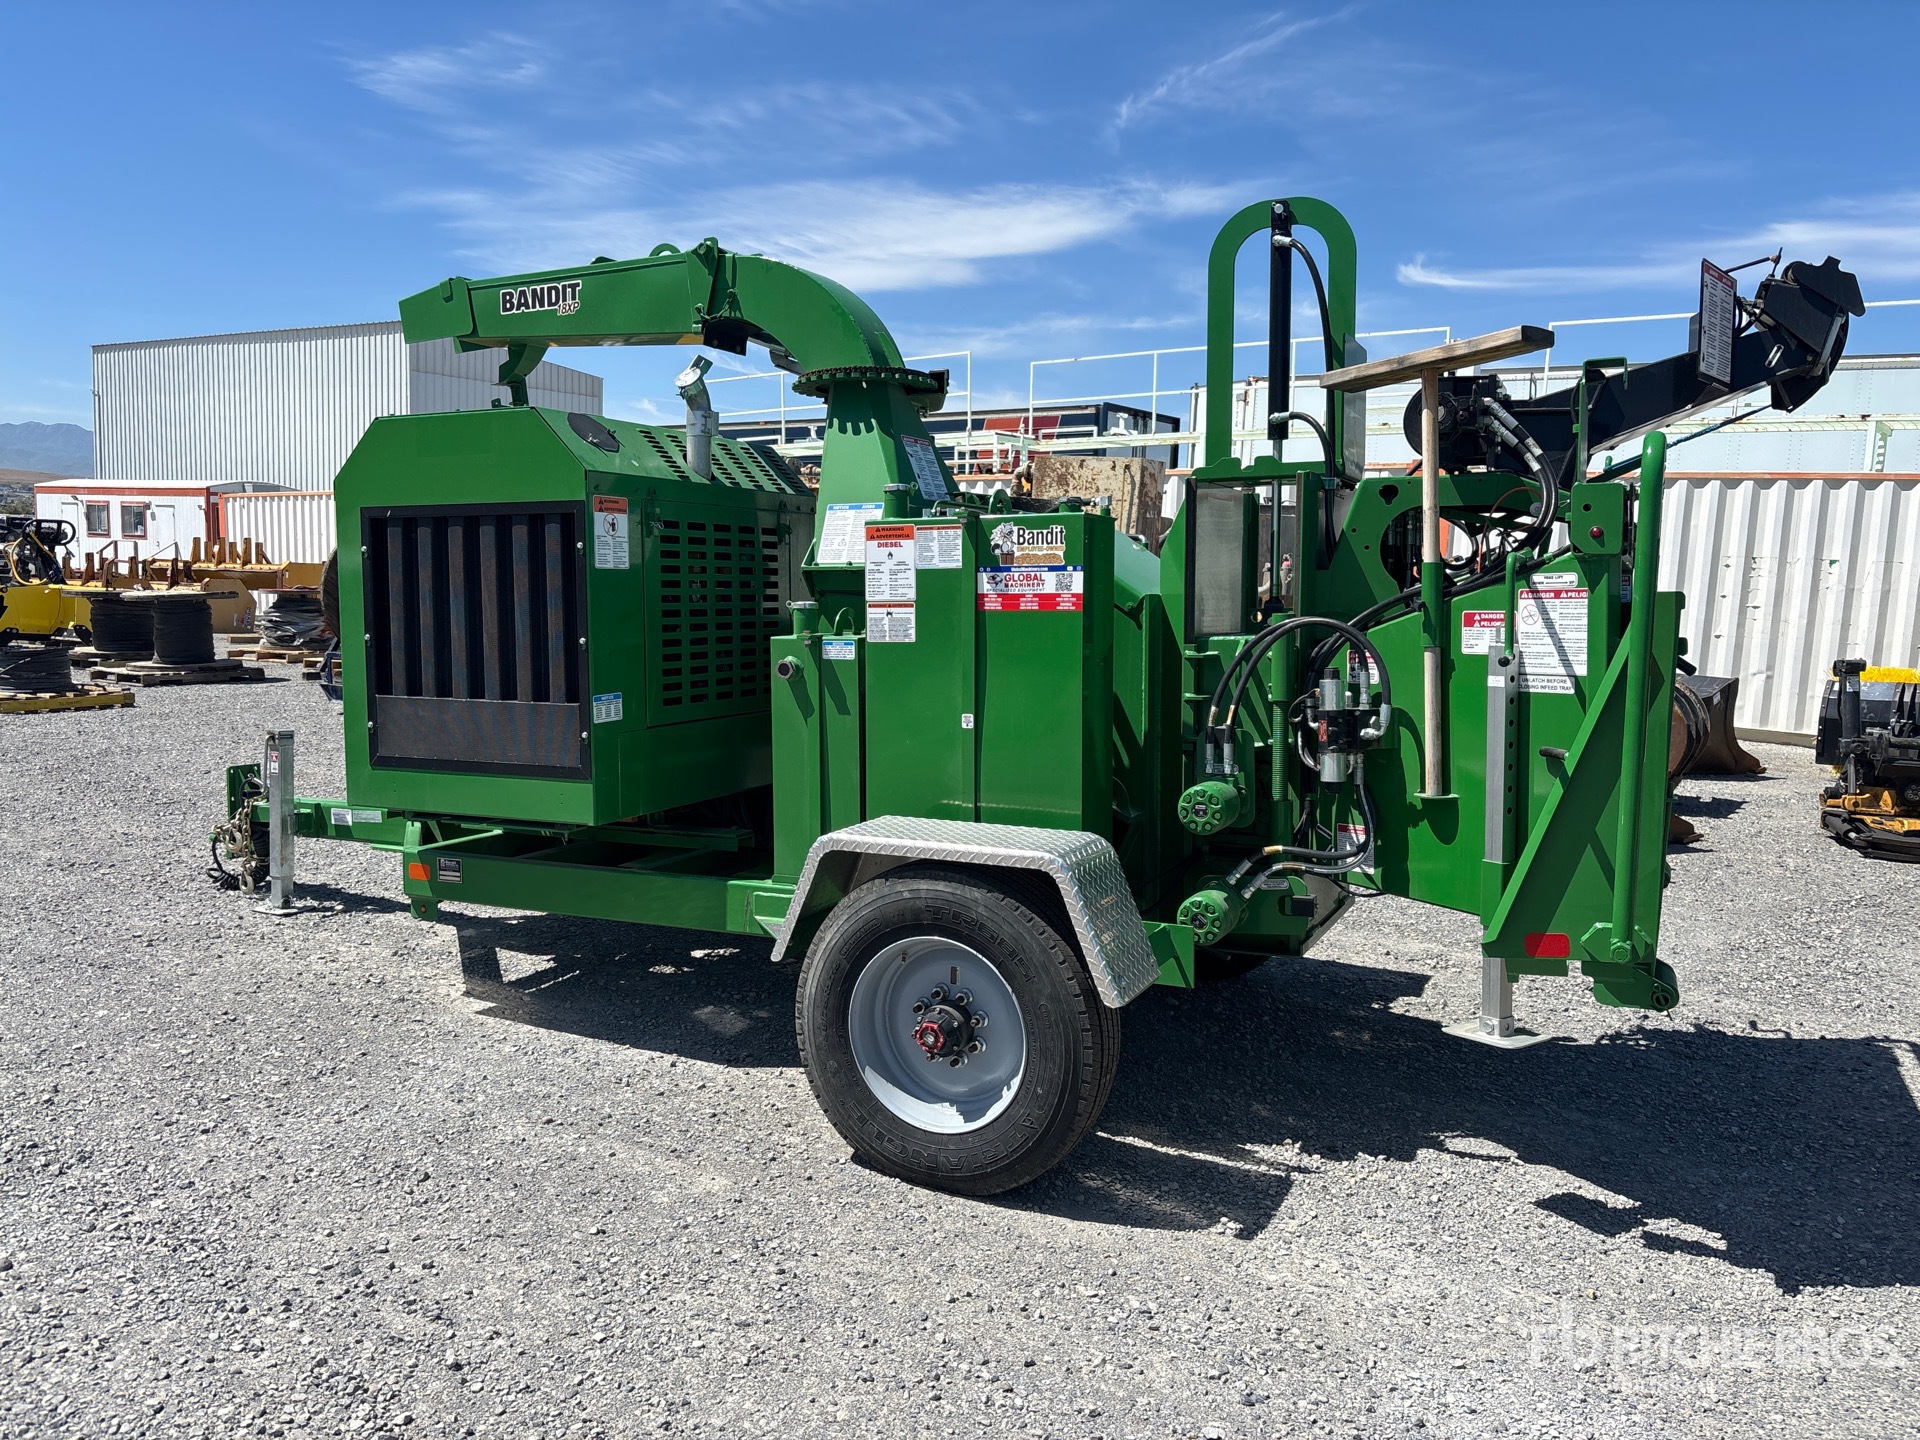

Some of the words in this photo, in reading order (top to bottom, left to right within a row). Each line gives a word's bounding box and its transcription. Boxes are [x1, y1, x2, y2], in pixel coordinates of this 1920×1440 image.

[501, 281, 580, 313] BANDIT
[557, 302, 579, 315] 18XP
[1016, 525, 1065, 546] Bandit
[1004, 573, 1046, 582] GLOBAL
[849, 1103, 1032, 1170] TRIANGLE
